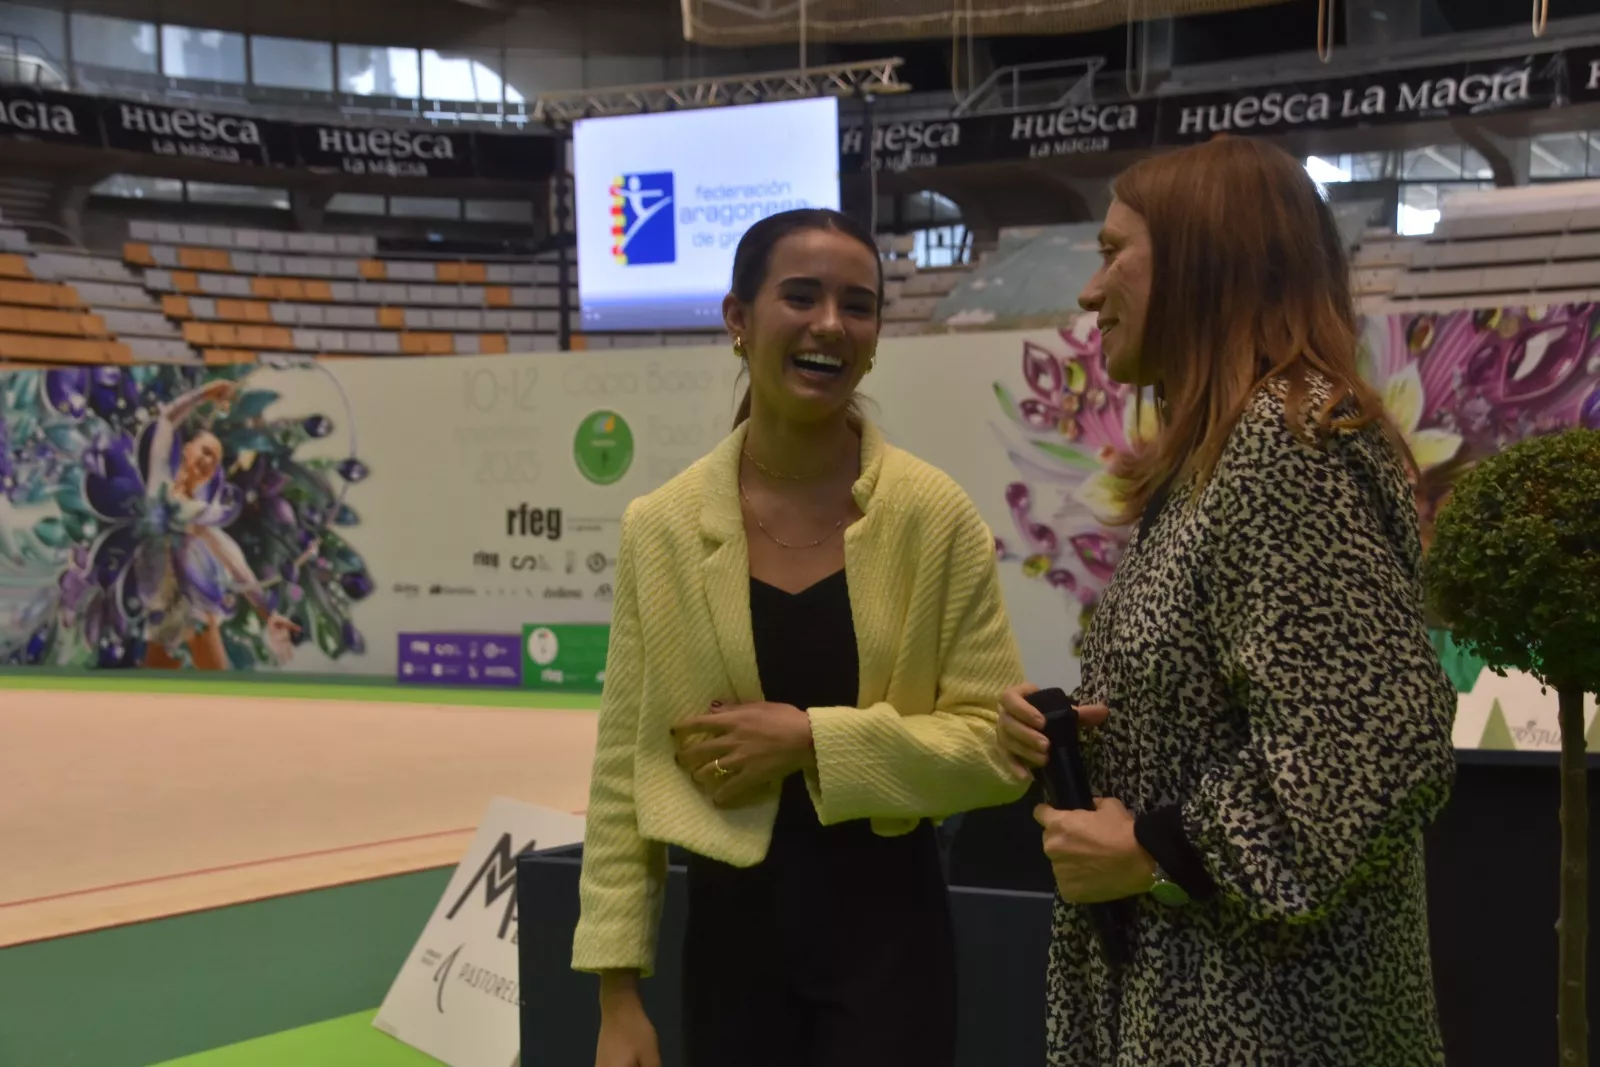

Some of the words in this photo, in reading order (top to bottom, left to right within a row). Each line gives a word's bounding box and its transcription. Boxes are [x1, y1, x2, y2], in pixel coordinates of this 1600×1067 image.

[120, 103, 260, 145] Huesca
[1010, 103, 1139, 140] Huesca
[1178, 92, 1330, 134] Huesca
[1341, 85, 1386, 118] La
[317, 127, 454, 159] Huesca
[506, 502, 563, 541] rfeg
